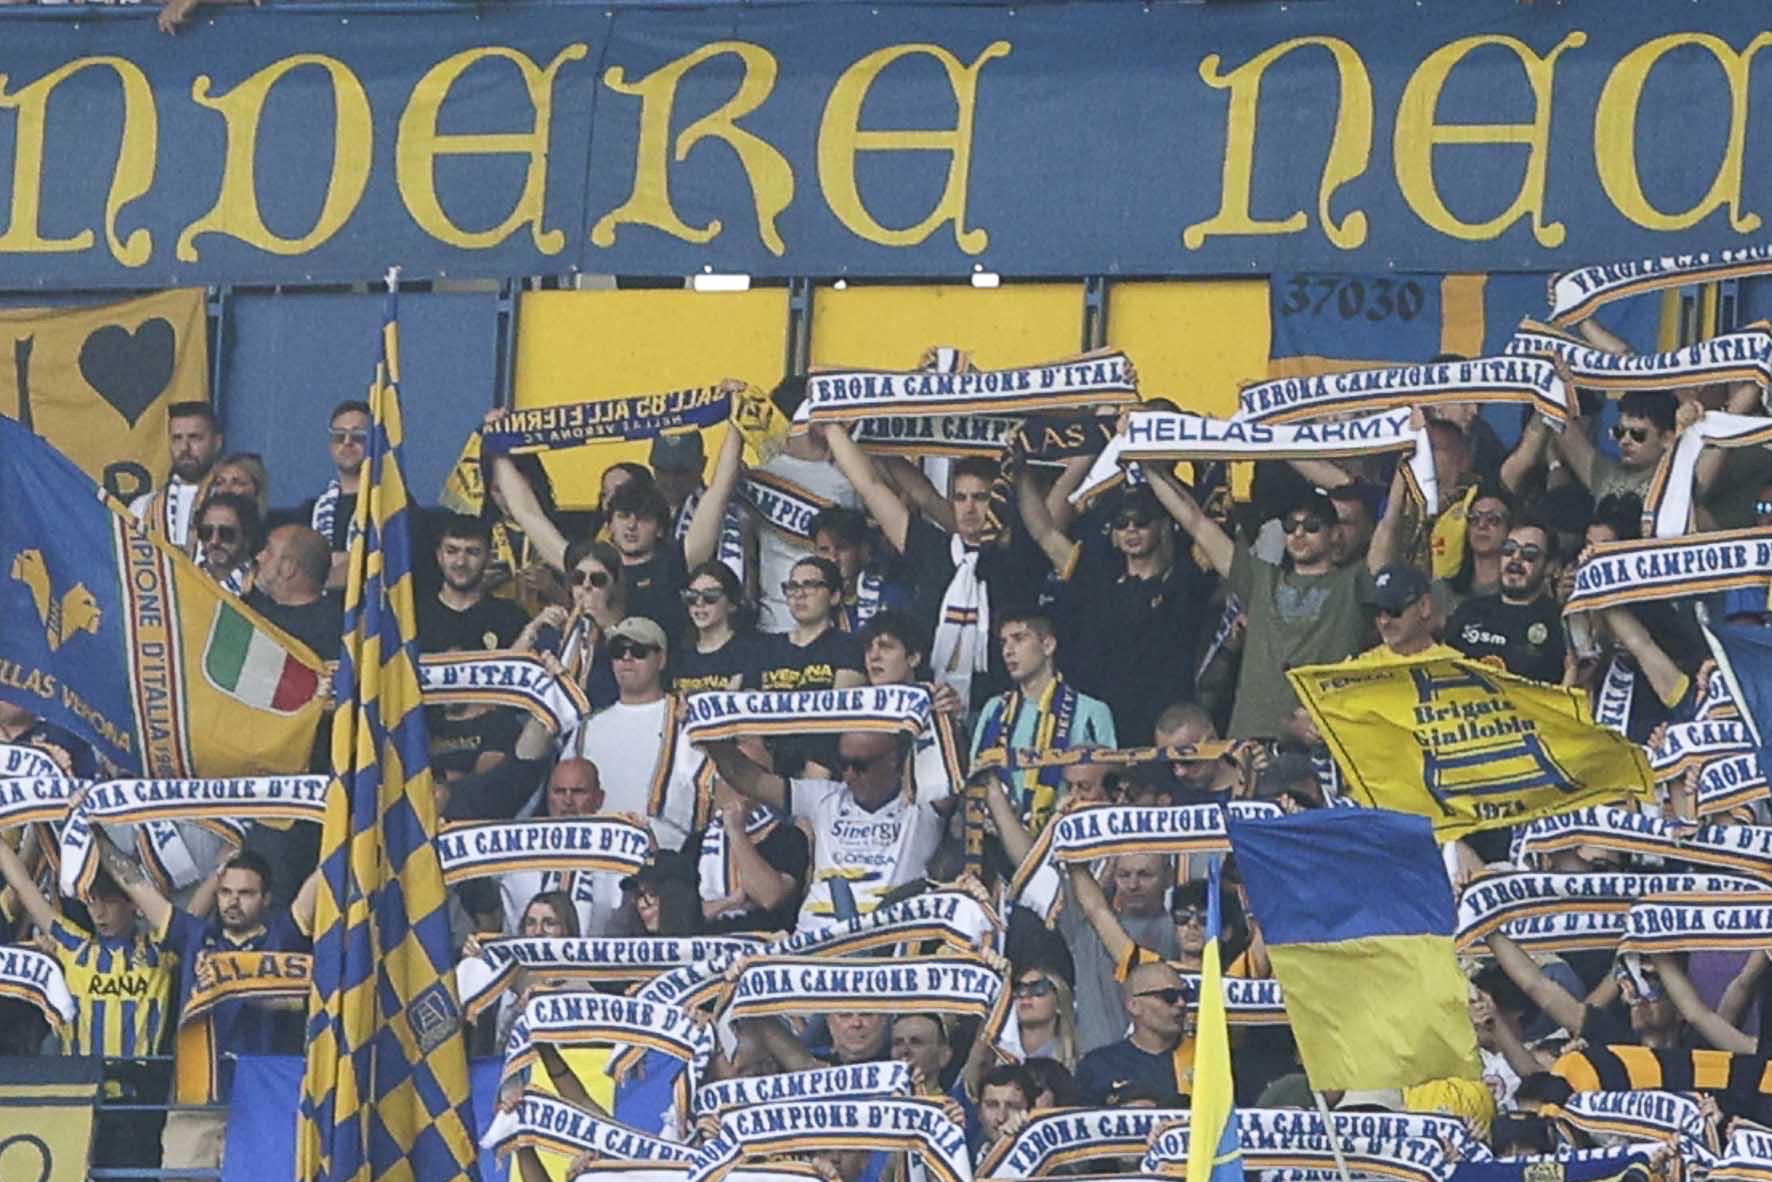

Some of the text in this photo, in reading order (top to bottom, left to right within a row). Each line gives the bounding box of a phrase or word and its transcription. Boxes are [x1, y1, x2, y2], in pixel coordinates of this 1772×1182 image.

[1281, 278, 1424, 321] 37030
[818, 372, 1031, 401] ERONA CAMPIONE
[1244, 357, 1554, 412] VERONA CAMPIONE D'ITALIA
[1129, 413, 1409, 444] HELLAS ARMY
[1636, 545, 1748, 577] CAMPIONE
[747, 689, 865, 712] CAMPIONE
[135, 780, 257, 805] CAMPIONE
[476, 828, 592, 853] CAMPIONE
[831, 820, 901, 843] Sinergy
[1467, 876, 1555, 914] VERONA
[564, 940, 680, 964] CAMPIONE
[88, 975, 148, 996] RANA
[801, 968, 919, 993] CAMPIONE
[535, 996, 652, 1024] CAMPIONE
[736, 1104, 860, 1129] CAMPIONE
[1009, 1119, 1092, 1176] VERONA
